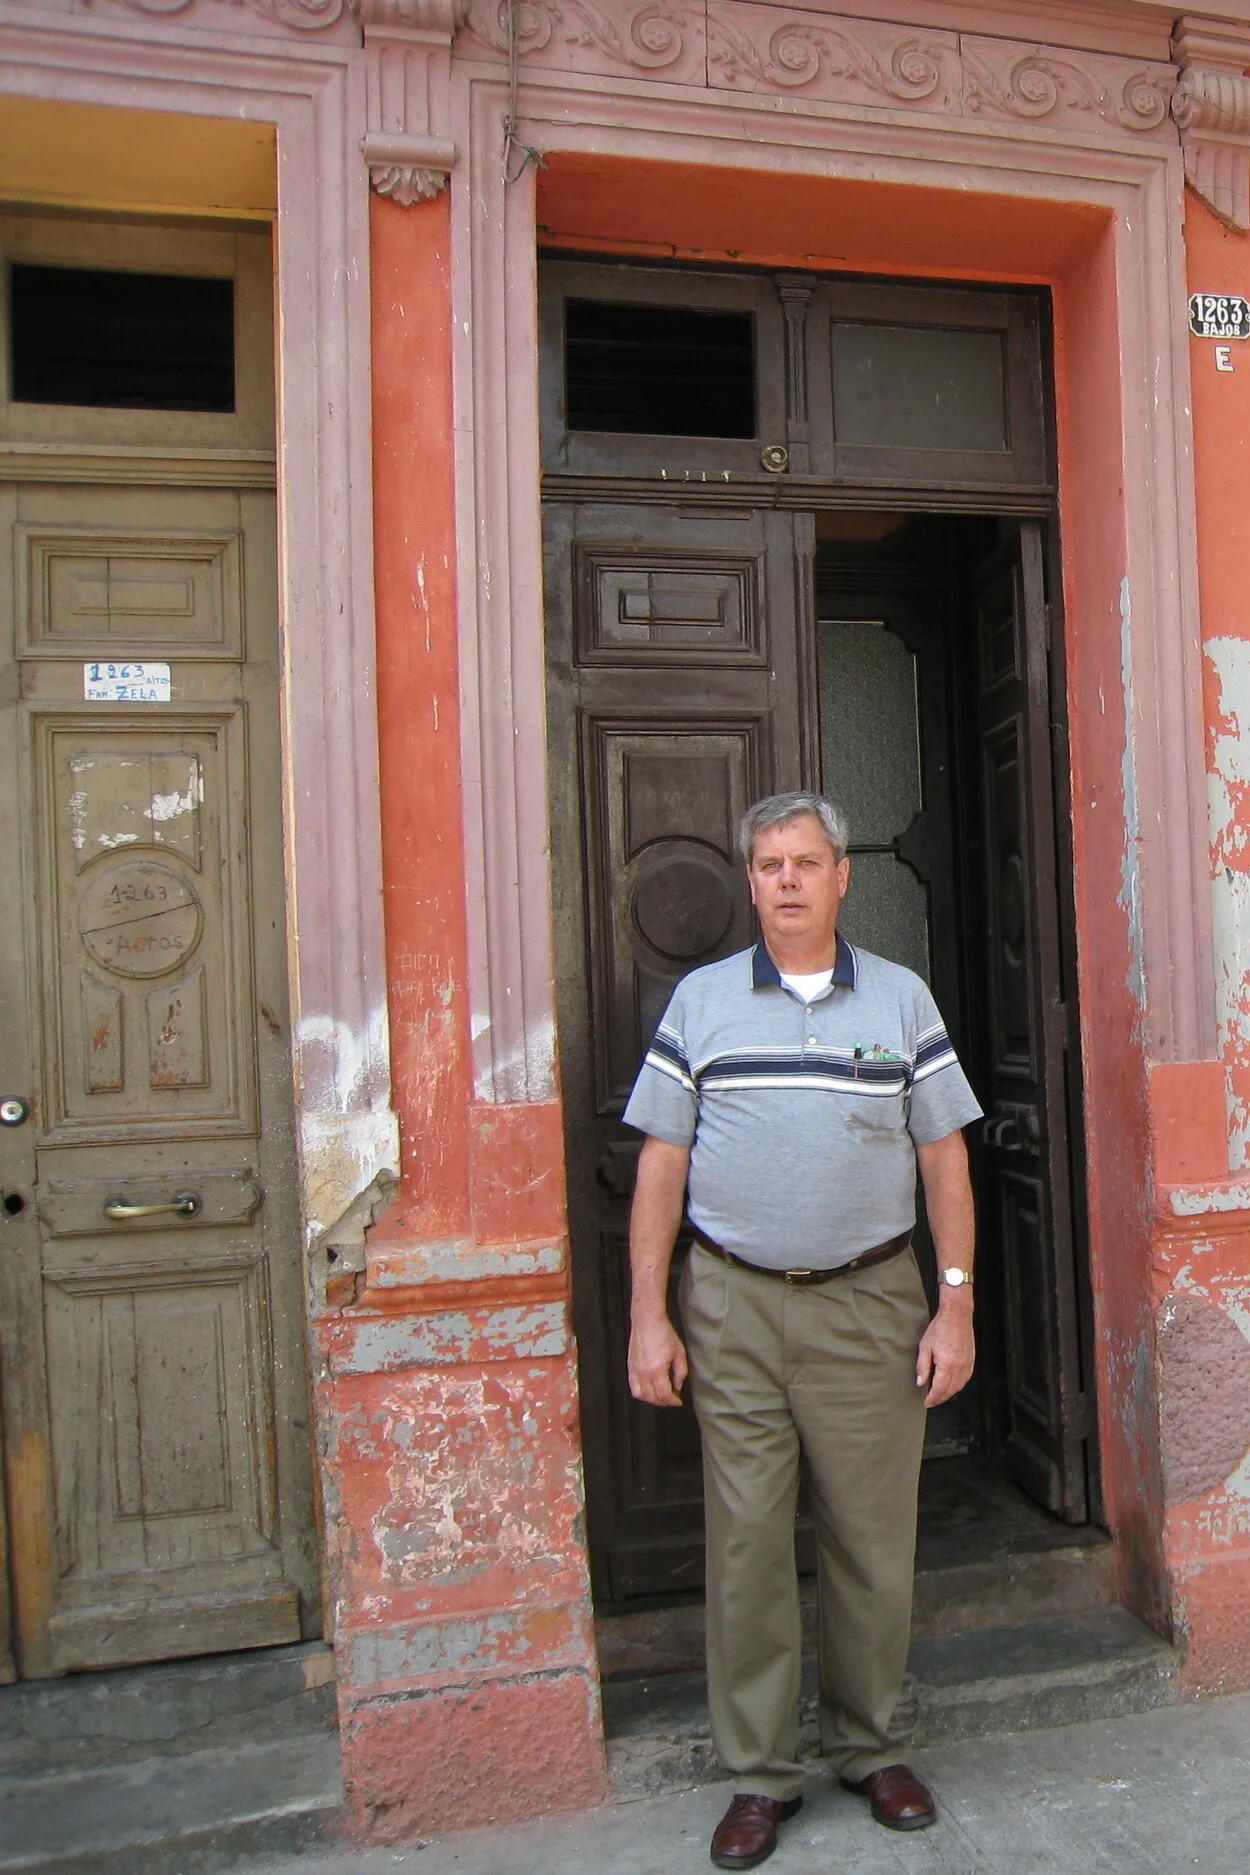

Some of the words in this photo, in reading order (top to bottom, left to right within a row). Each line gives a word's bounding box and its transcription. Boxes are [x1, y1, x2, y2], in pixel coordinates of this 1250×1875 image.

[1196, 296, 1243, 324] 1263
[1203, 322, 1241, 336] BAJOS
[1215, 346, 1235, 372] E
[89, 663, 146, 682] 1263
[115, 685, 158, 700] ZELA
[110, 884, 168, 904] 1263
